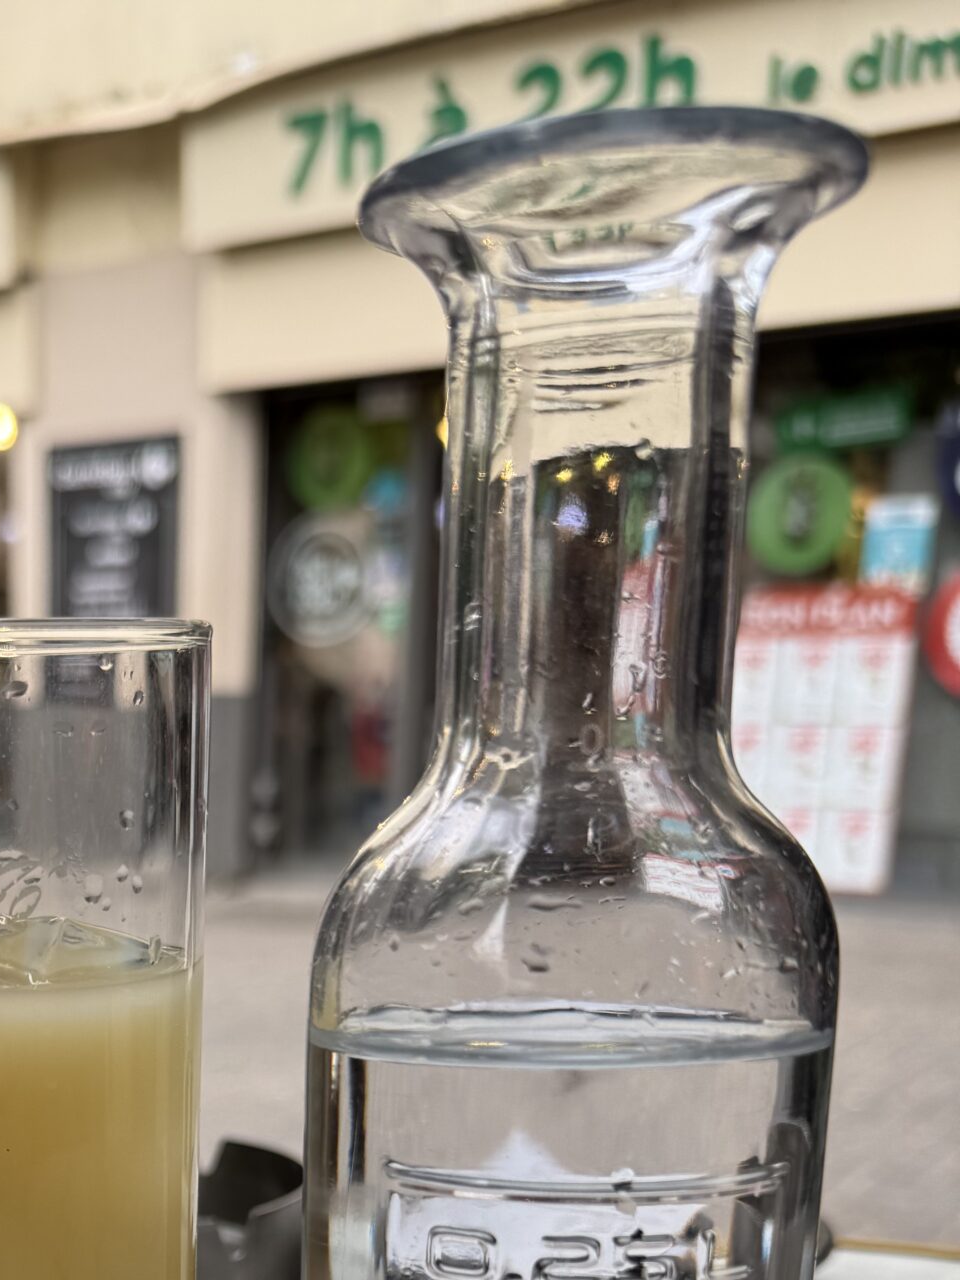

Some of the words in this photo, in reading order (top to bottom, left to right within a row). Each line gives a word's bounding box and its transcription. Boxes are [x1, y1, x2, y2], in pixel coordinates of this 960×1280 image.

[284, 96, 384, 198] 7h
[516, 34, 696, 119] 22h
[769, 54, 818, 104] le
